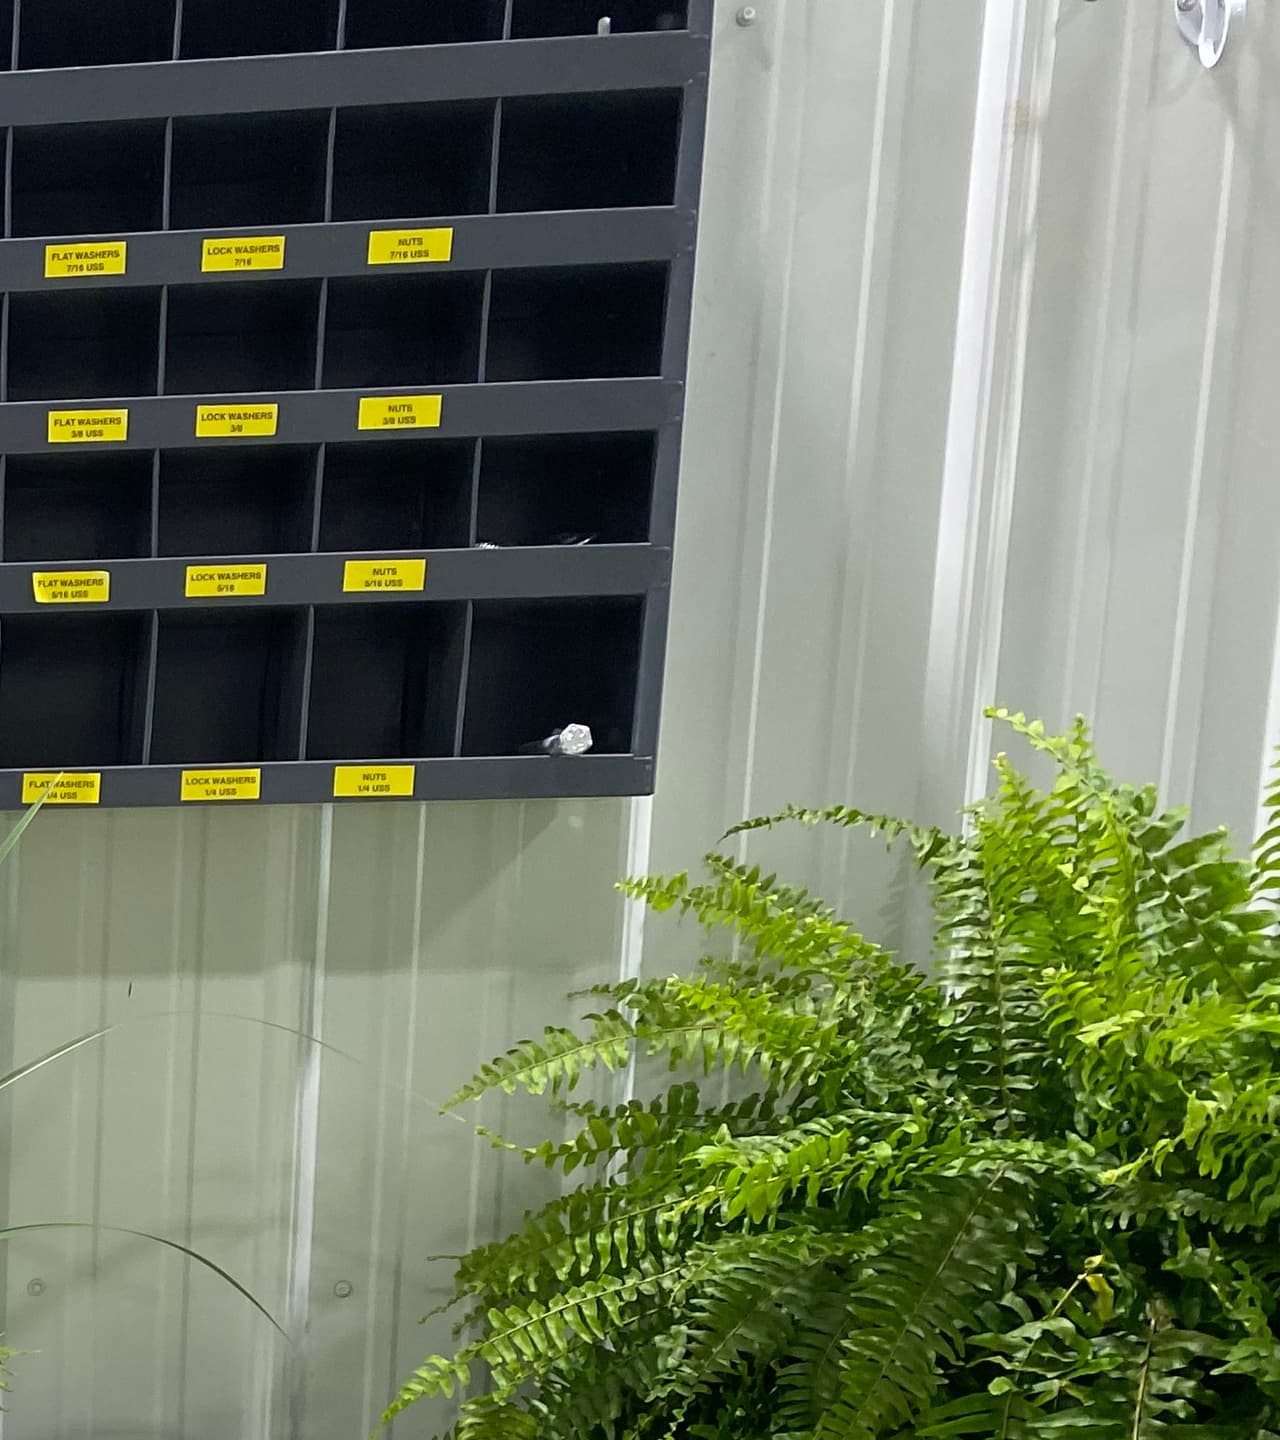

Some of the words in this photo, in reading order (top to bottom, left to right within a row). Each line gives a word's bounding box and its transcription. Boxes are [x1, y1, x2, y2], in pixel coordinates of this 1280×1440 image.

[397, 237, 424, 247] NUTS
[207, 246, 233, 256] LOCK
[234, 244, 281, 255] WASHERS
[390, 250, 409, 260] 7/16
[410, 249, 430, 259] USS
[51, 251, 74, 262] FLAT
[74, 249, 121, 260] WASHERS
[234, 257, 252, 266] 7/16
[66, 263, 85, 273] 7/16
[86, 262, 105, 272] USS
[387, 403, 413, 413] NUTS
[53, 418, 77, 427] FLAT
[77, 416, 122, 426] WASHERS
[201, 412, 227, 422] LOCK
[227, 411, 273, 421] WASHERS
[397, 415, 417, 425] USS
[85, 429, 104, 438] USS
[190, 573, 216, 582] LOCK
[216, 571, 262, 581] WASHERS
[372, 567, 398, 576] NUTS
[37, 579, 60, 588] FLAT
[59, 578, 104, 588] WASHERS
[364, 579, 383, 588] 5/16
[384, 578, 403, 588] USS
[216, 584, 235, 593] 5/16
[51, 590, 69, 599] 5/16
[70, 589, 89, 599] USS
[185, 777, 211, 786] LOCK
[211, 776, 257, 785] WASHERS
[362, 772, 387, 782] NUTS
[28, 780, 51, 789] FLAT
[357, 784, 370, 793] 1/4
[371, 784, 391, 793] USS
[59, 791, 78, 800] USS
[204, 788, 217, 797] 1/4
[218, 787, 238, 796] USS
